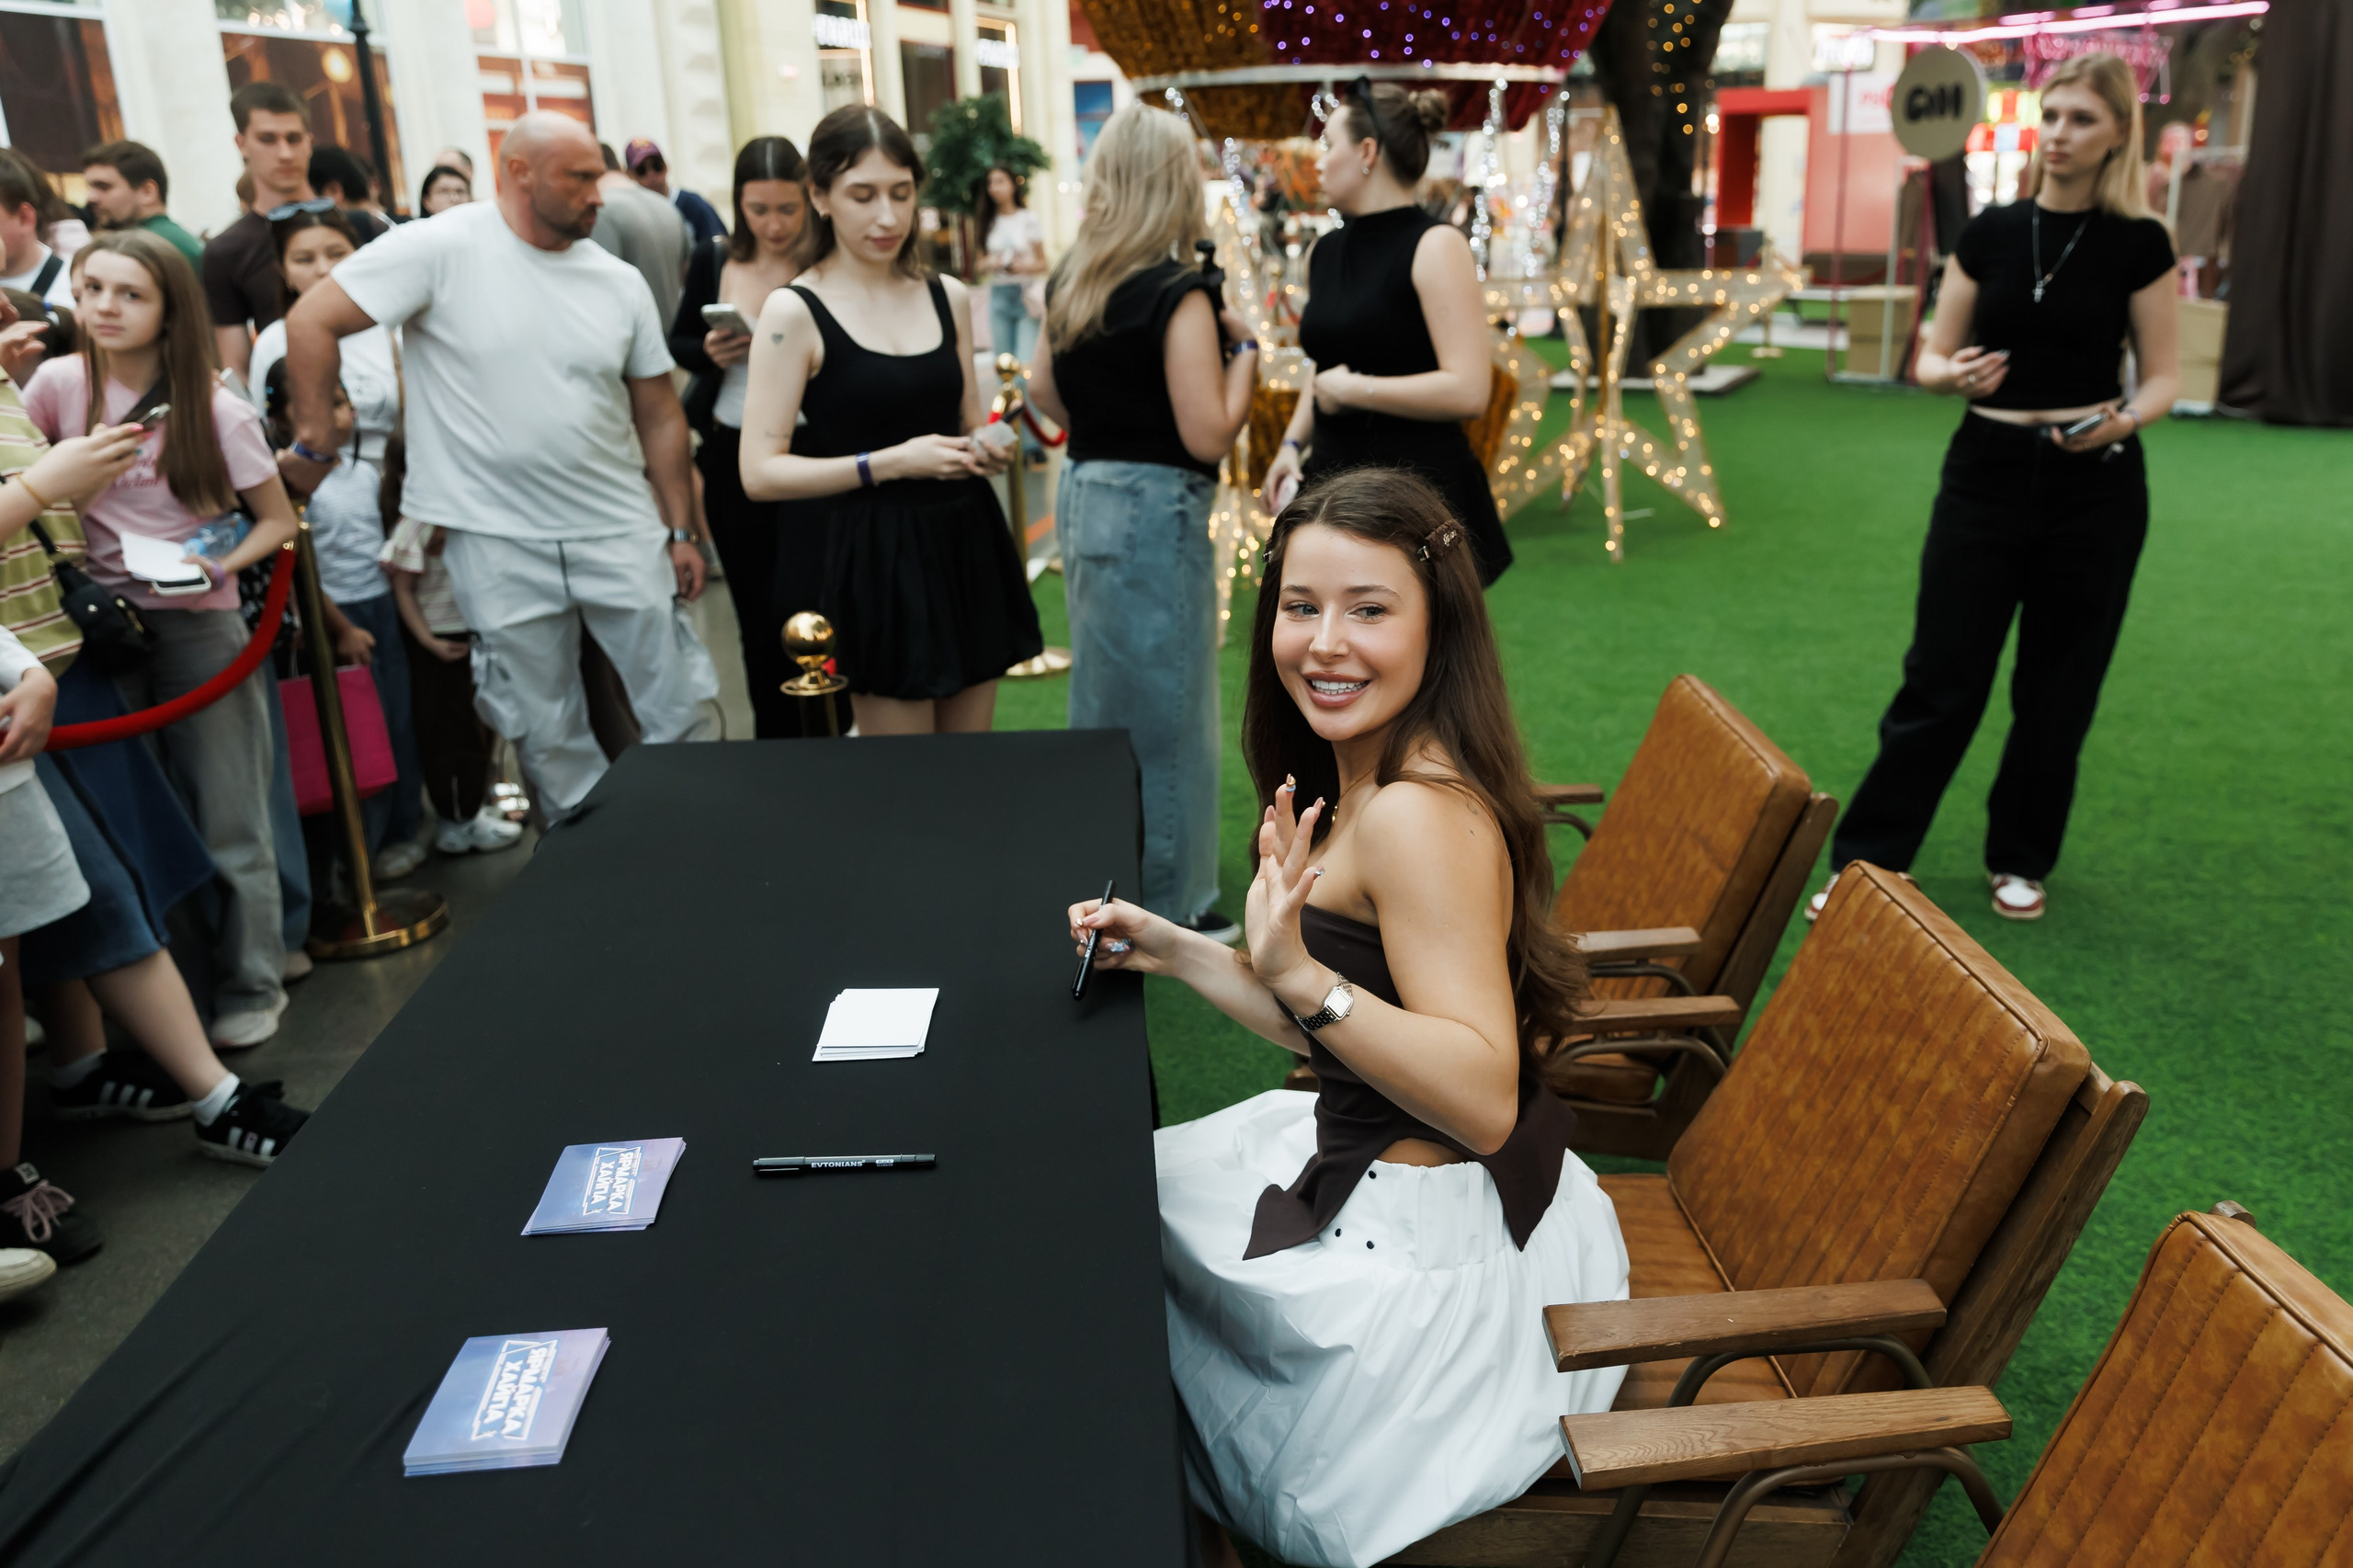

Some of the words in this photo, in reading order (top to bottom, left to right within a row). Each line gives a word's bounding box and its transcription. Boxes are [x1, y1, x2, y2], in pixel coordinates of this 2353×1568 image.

[590, 1160, 616, 1204] ХАЙПА
[608, 1152, 634, 1210] ЯРМАРКА
[483, 1359, 523, 1424] ХАЙПА
[501, 1346, 548, 1435] ЯРМАРКА
